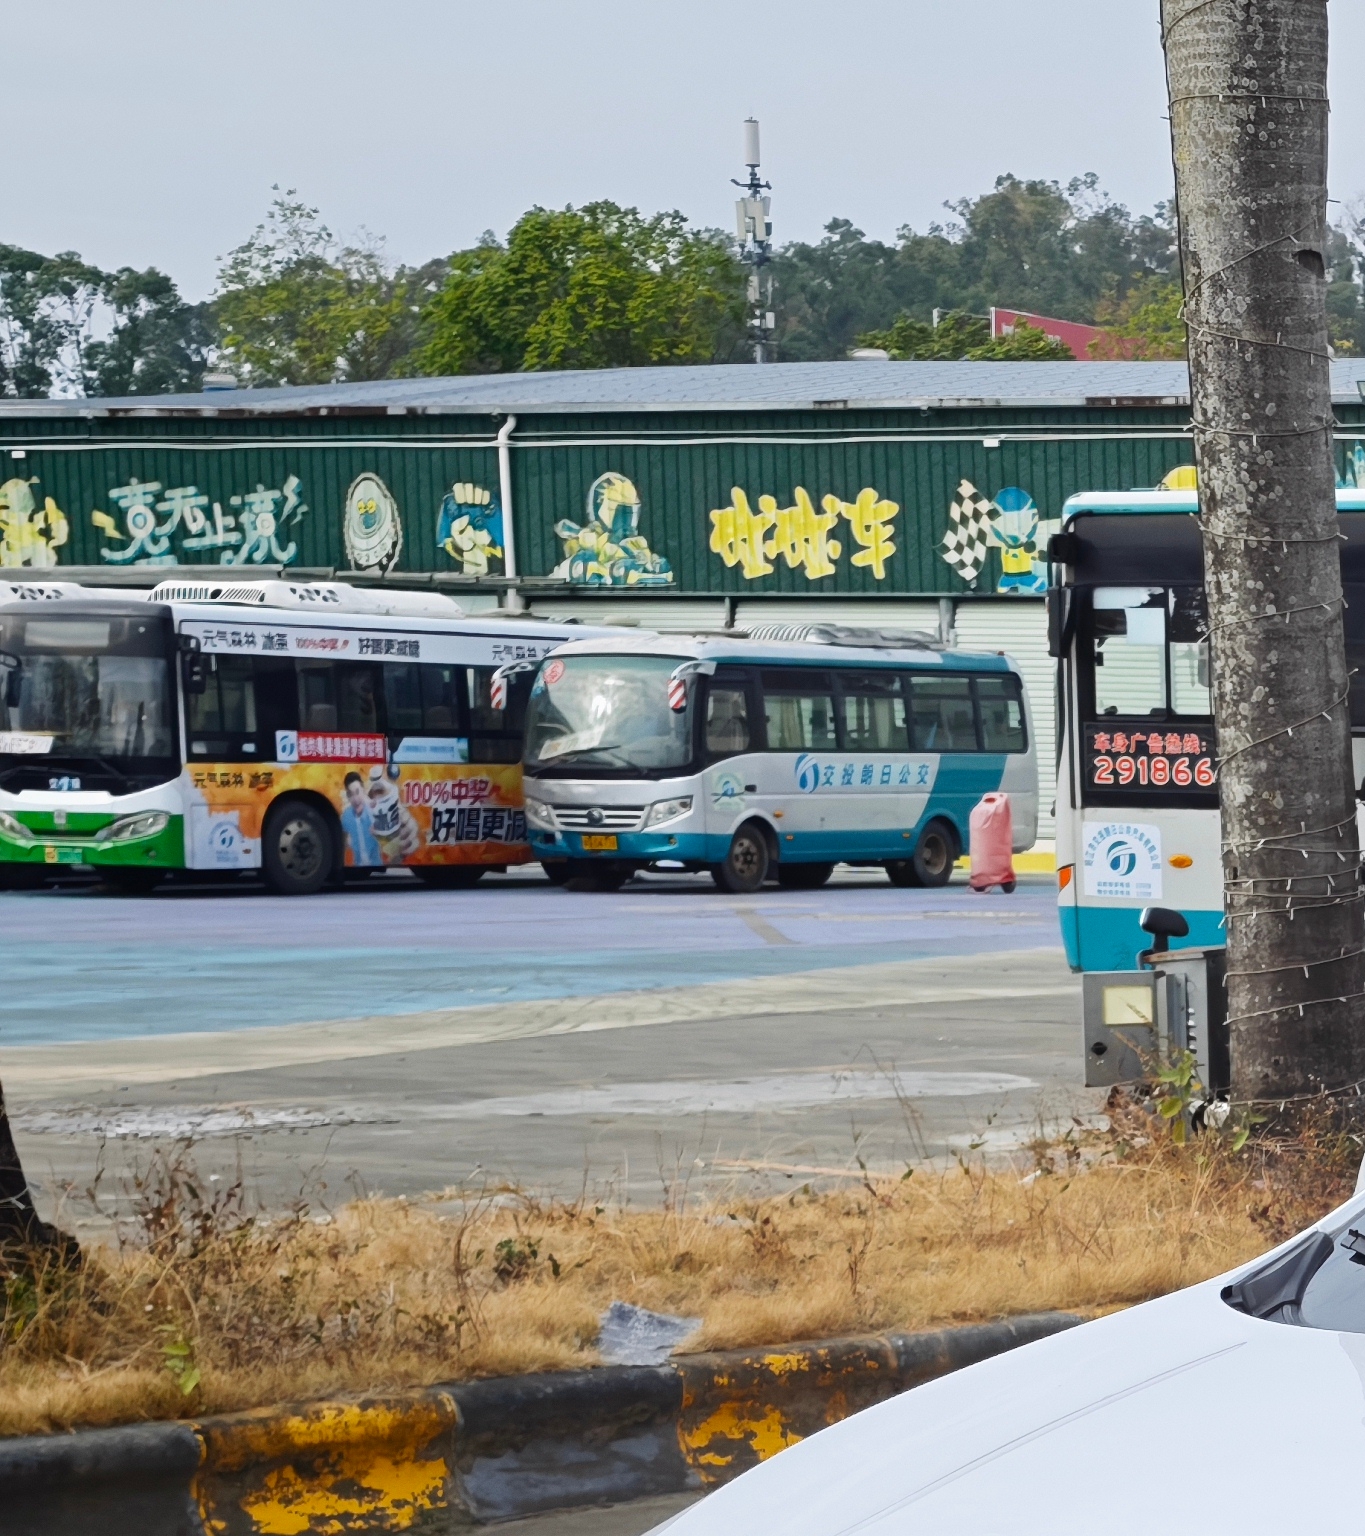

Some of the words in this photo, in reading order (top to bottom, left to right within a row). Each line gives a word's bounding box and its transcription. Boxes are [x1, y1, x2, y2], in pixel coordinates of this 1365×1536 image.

[821, 763, 930, 786] 交投朗日公交
[403, 778, 490, 806] 100%中奖
